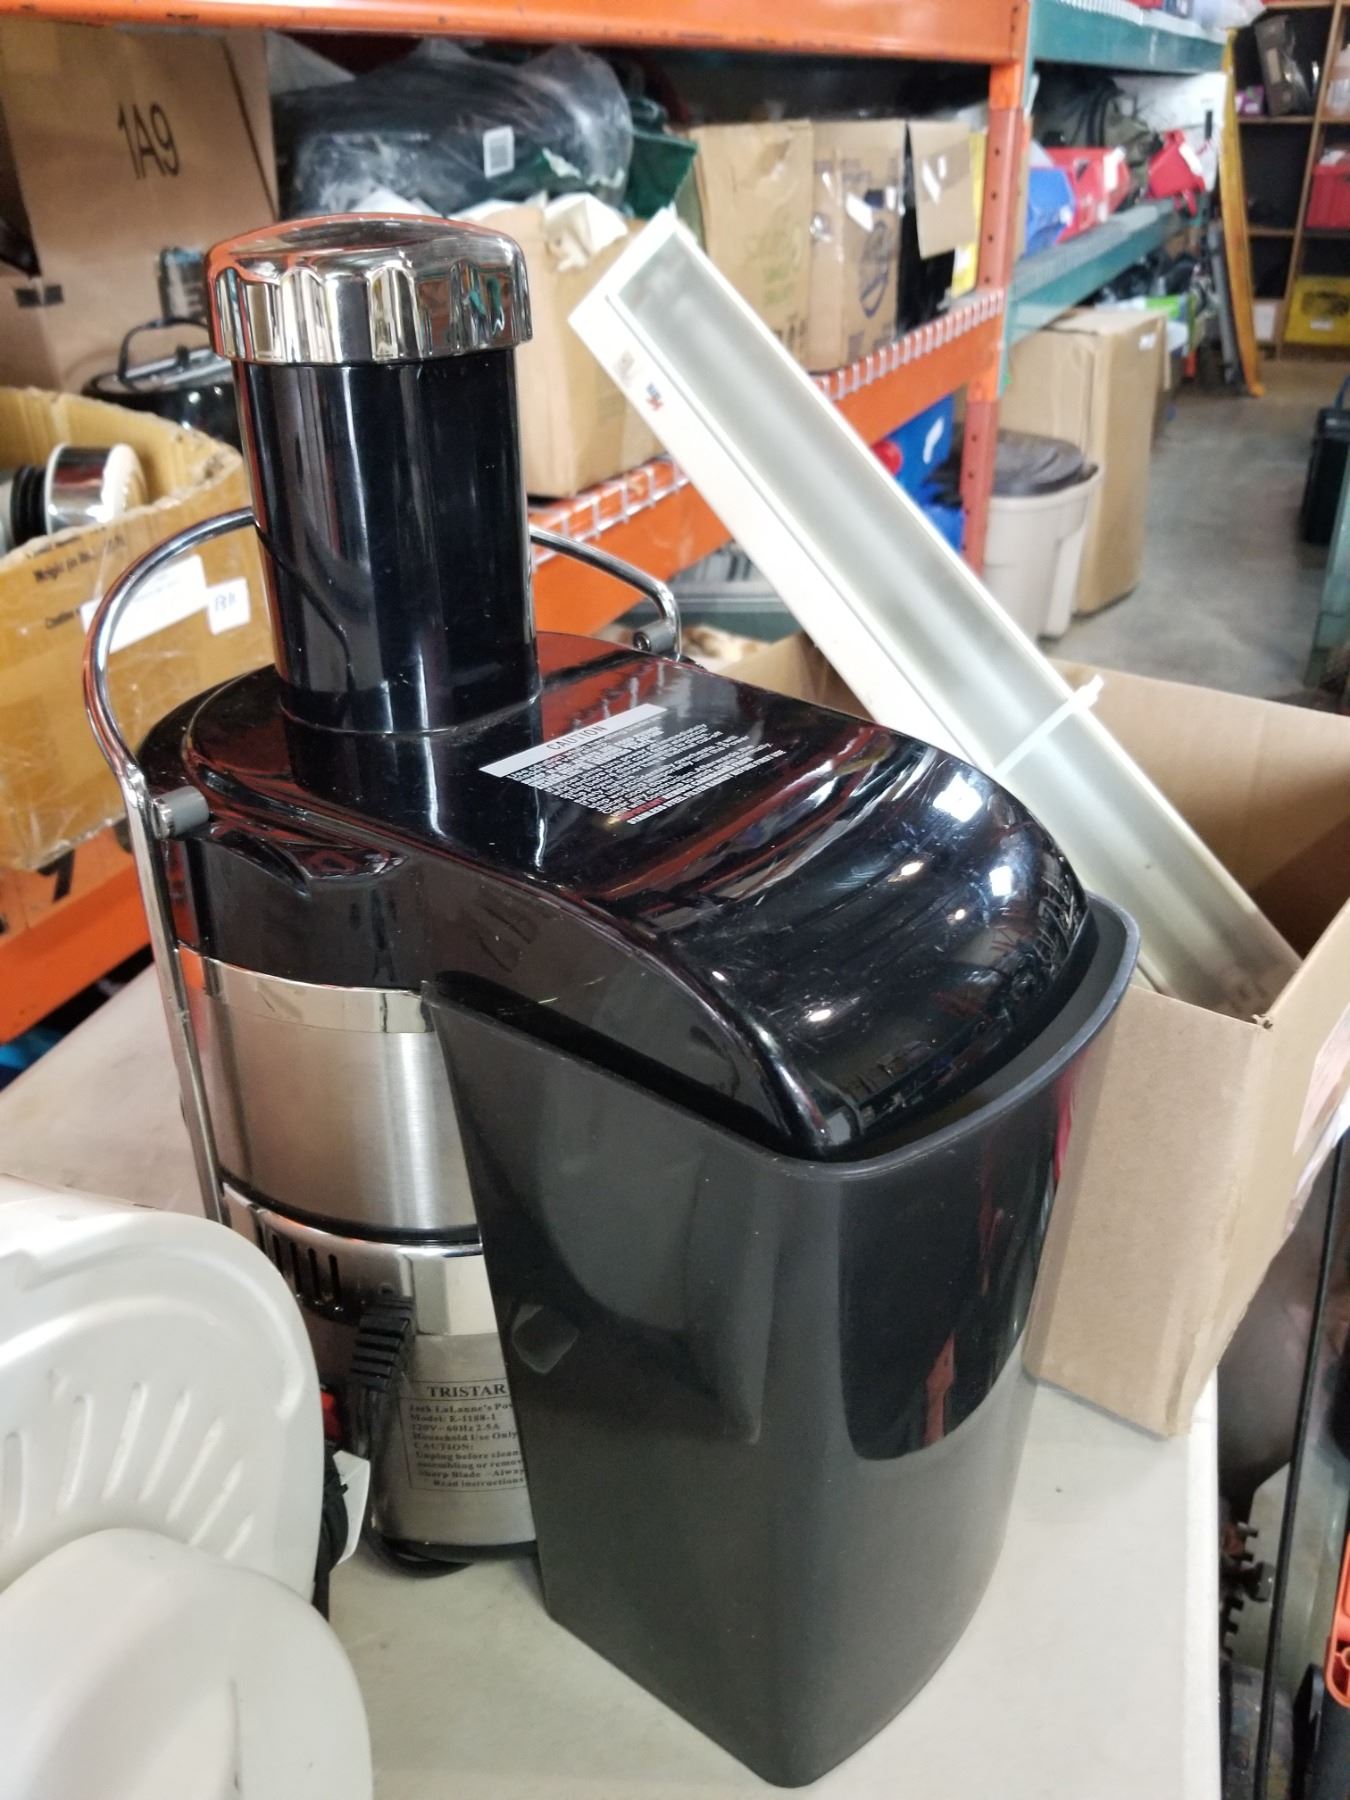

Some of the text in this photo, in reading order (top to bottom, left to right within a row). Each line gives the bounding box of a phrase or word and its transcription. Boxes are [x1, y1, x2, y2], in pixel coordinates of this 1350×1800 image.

[117, 101, 179, 179] 1A9
[544, 725, 608, 750] CAUTION
[427, 1384, 506, 1397] TRISTAR
